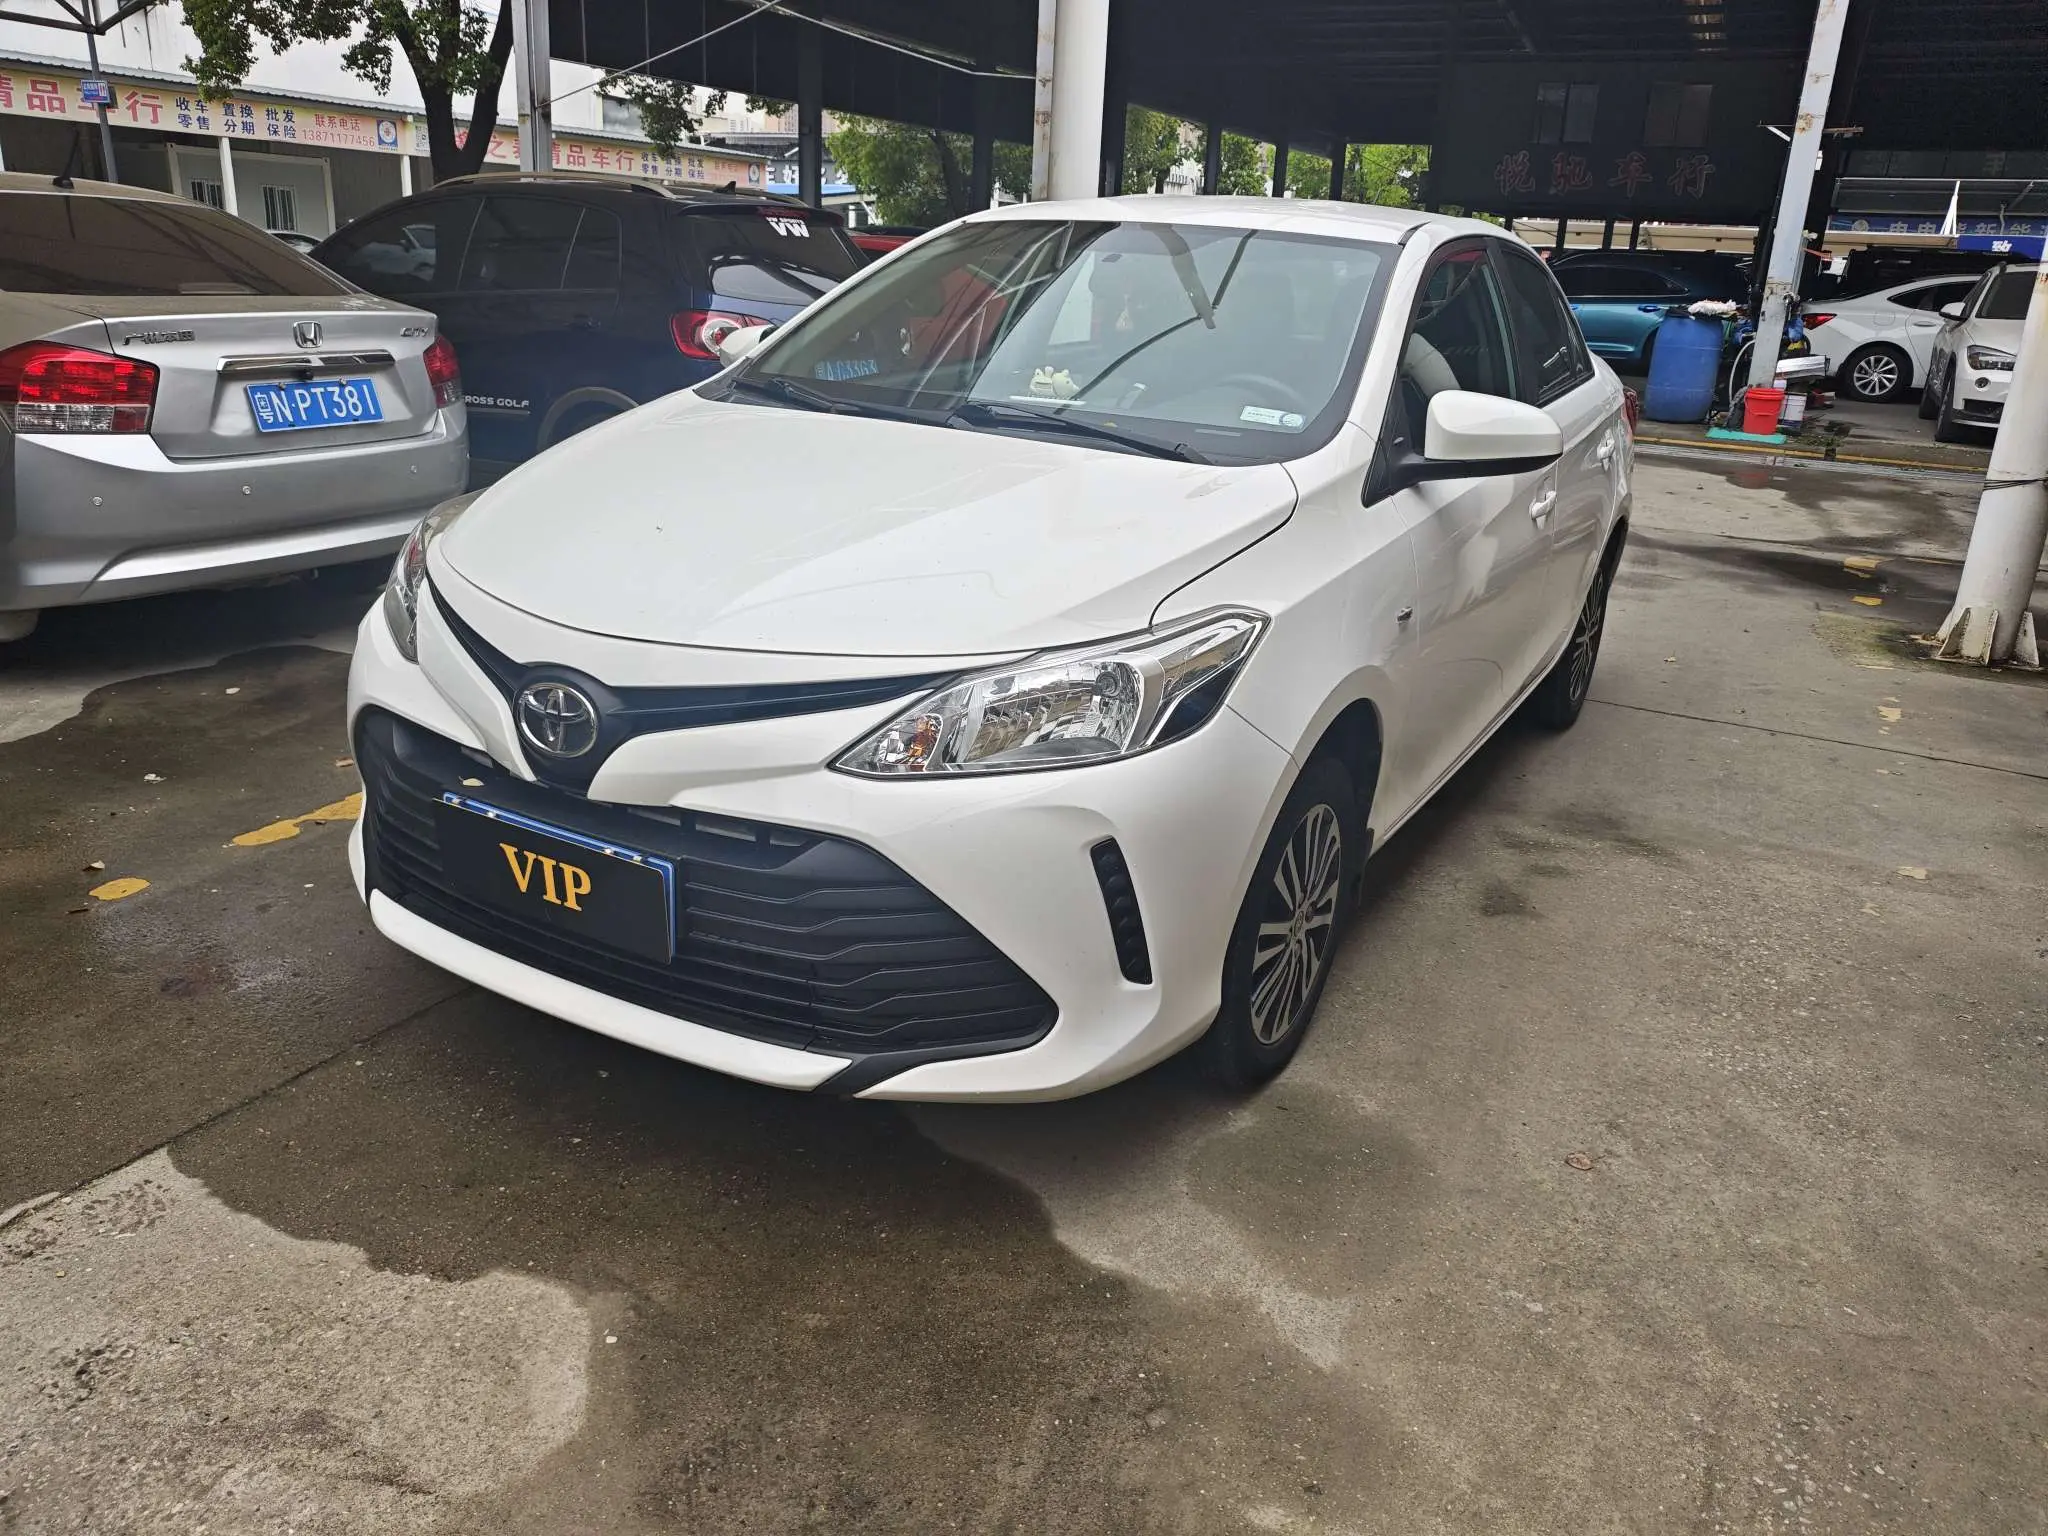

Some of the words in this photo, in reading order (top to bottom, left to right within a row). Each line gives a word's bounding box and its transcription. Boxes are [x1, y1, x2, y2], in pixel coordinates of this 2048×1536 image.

[176, 97, 208, 114] 收车
[222, 102, 254, 119] 置换
[265, 108, 295, 123] 批发
[178, 114, 210, 131] 零售
[224, 119, 255, 135] 分期
[267, 123, 297, 139] 保险
[314, 113, 360, 131] 联系电话
[770, 221, 810, 238] VW
[497, 398, 530, 408] GOLF
[499, 842, 592, 912] VIP
